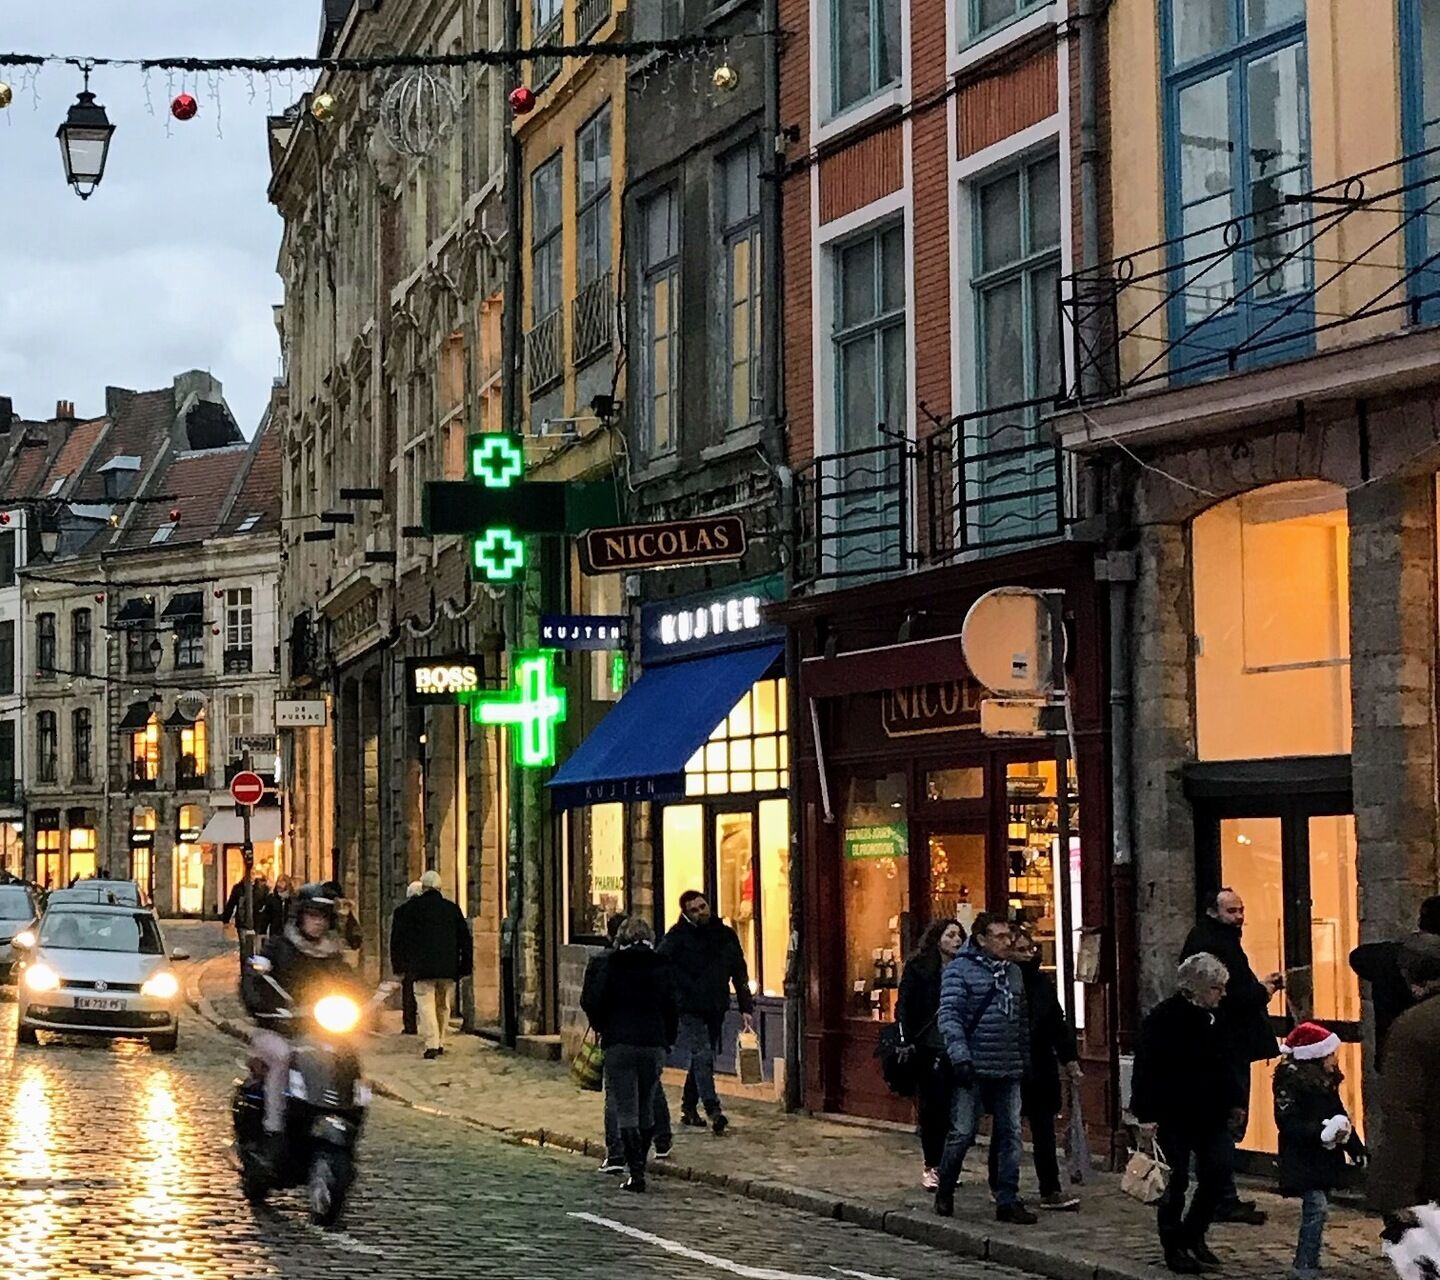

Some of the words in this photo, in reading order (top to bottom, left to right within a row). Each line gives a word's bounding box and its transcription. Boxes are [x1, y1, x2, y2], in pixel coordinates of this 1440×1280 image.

[604, 524, 729, 561] NICOLAS
[543, 625, 620, 640] KUJTEN
[415, 666, 478, 688] BOSS
[585, 780, 655, 799] KUJTEN
